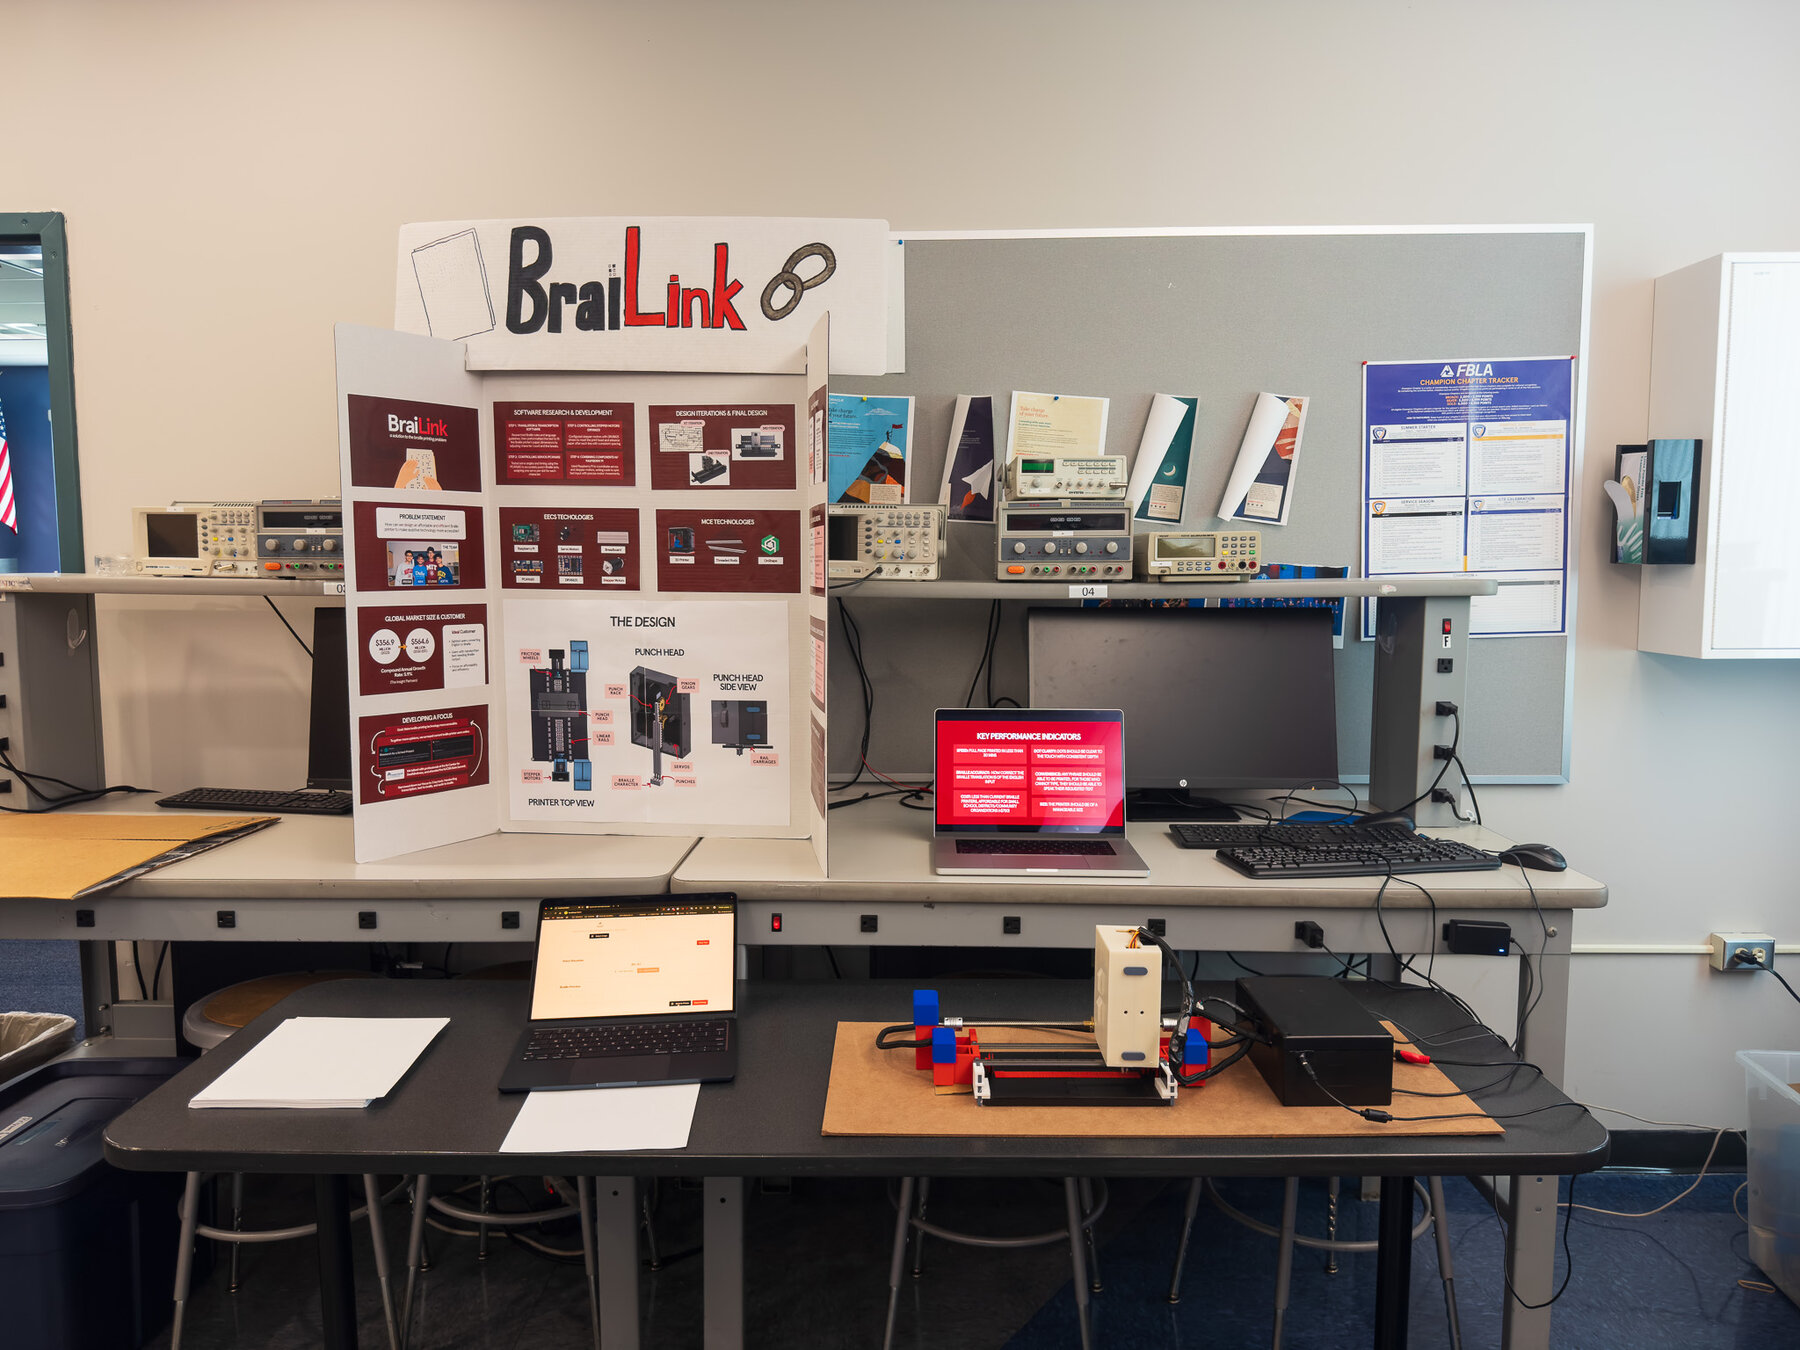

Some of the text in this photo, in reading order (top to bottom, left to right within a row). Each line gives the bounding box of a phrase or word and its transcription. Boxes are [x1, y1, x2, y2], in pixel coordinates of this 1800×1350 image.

[505, 225, 747, 334] BraiLink
[1456, 364, 1493, 377] FBLA
[388, 413, 448, 436] BraiLink
[1082, 588, 1094, 596] 04
[610, 616, 676, 627] THE DESIGN
[1444, 636, 1449, 647] F
[402, 715, 432, 724] DEVELOPING
